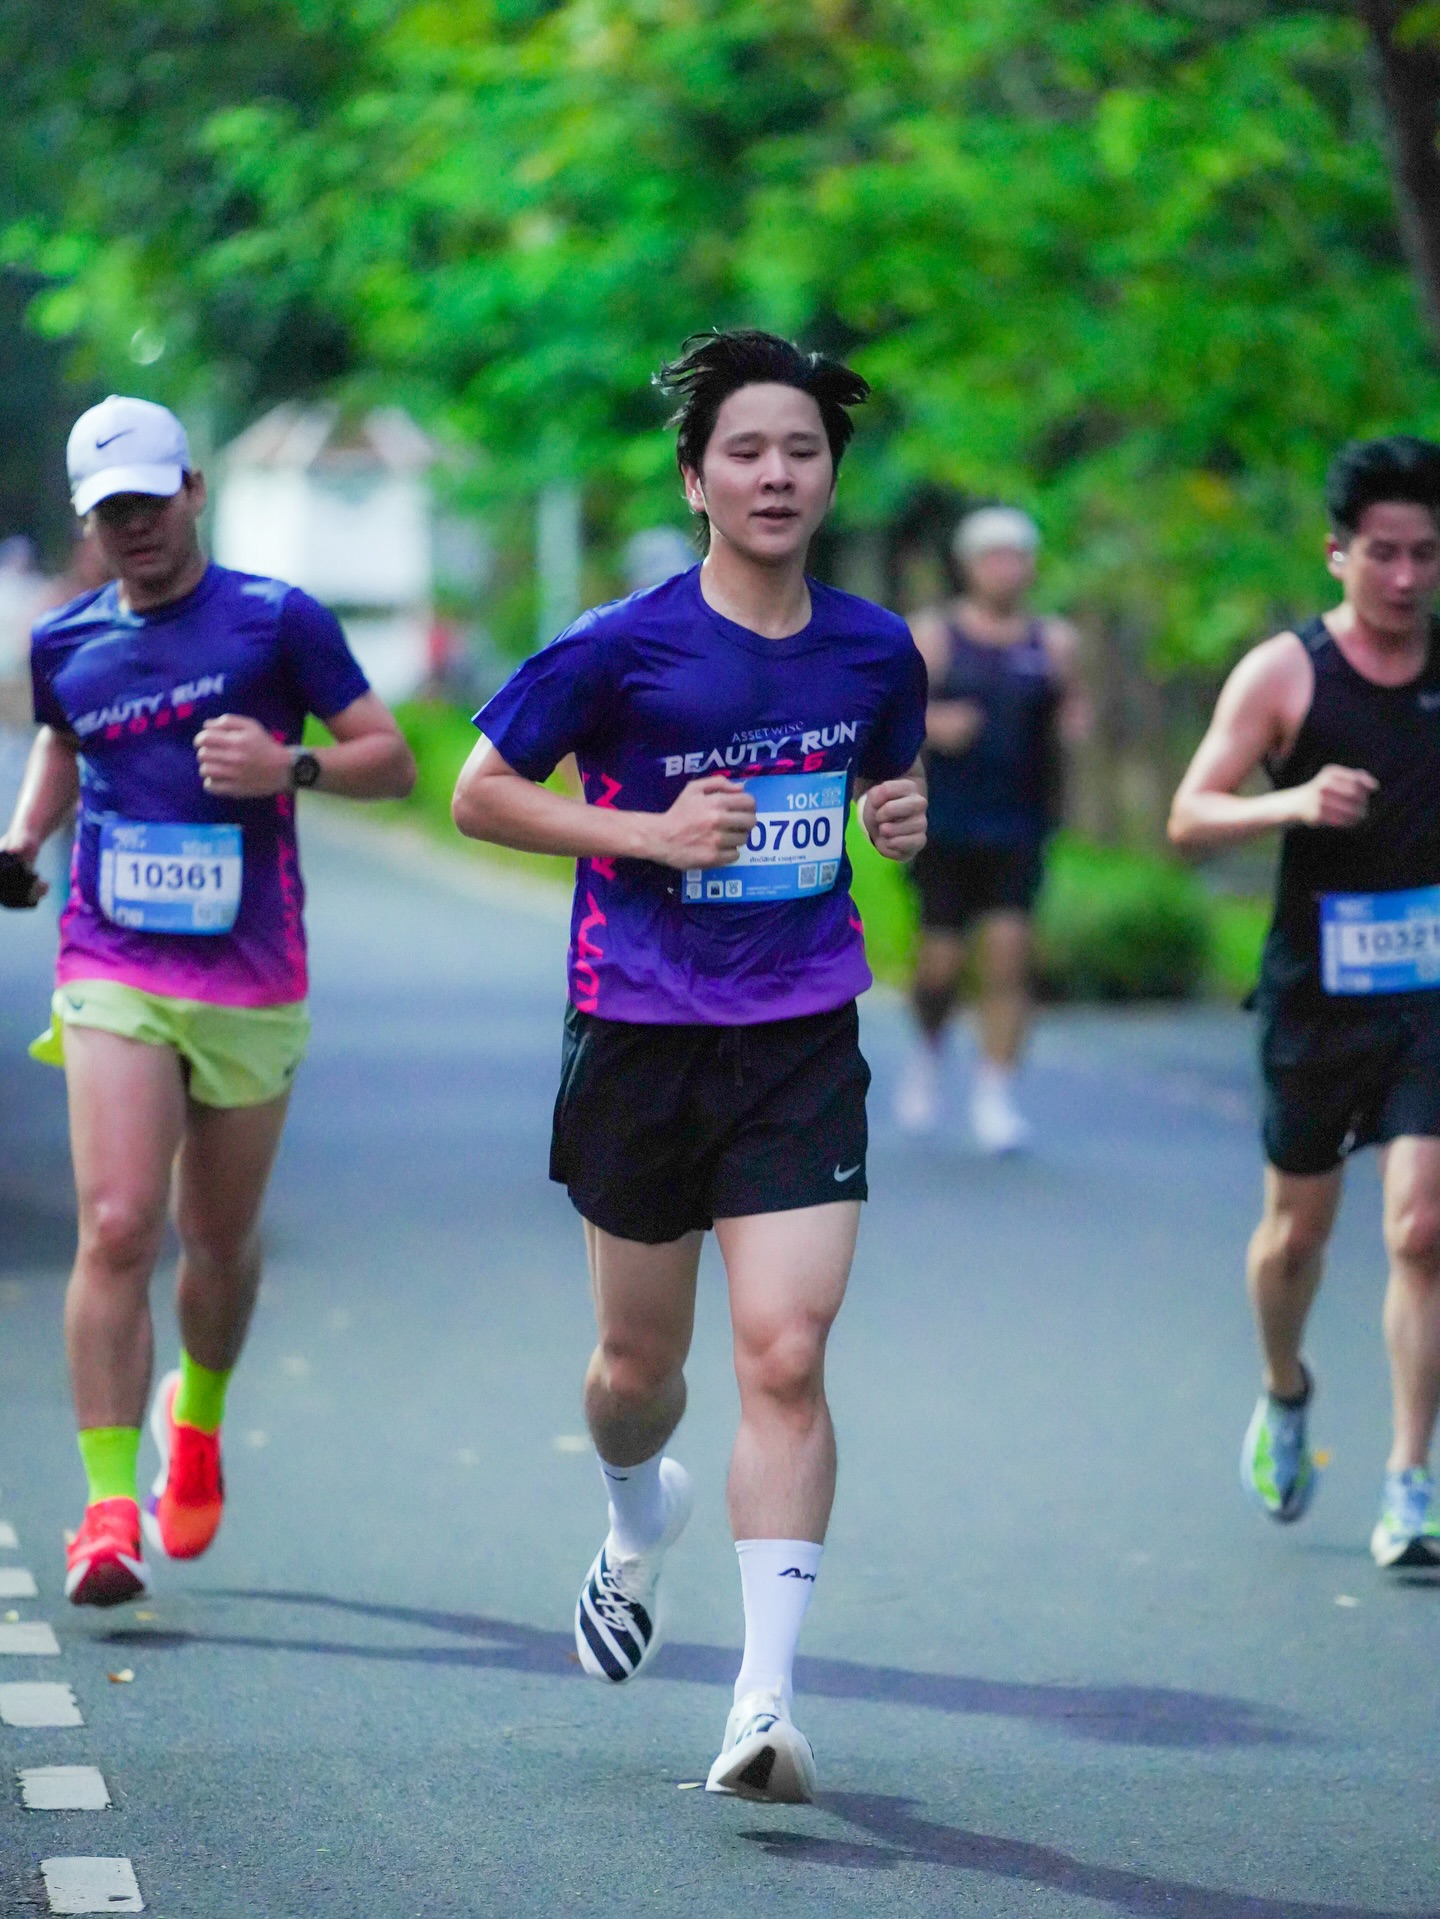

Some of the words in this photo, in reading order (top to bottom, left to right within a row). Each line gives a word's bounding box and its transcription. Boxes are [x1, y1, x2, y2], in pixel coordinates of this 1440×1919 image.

[665, 735, 791, 777] BEAUTY
[800, 720, 857, 755] RUN
[786, 792, 820, 810] 10K
[129, 861, 224, 890] 10361
